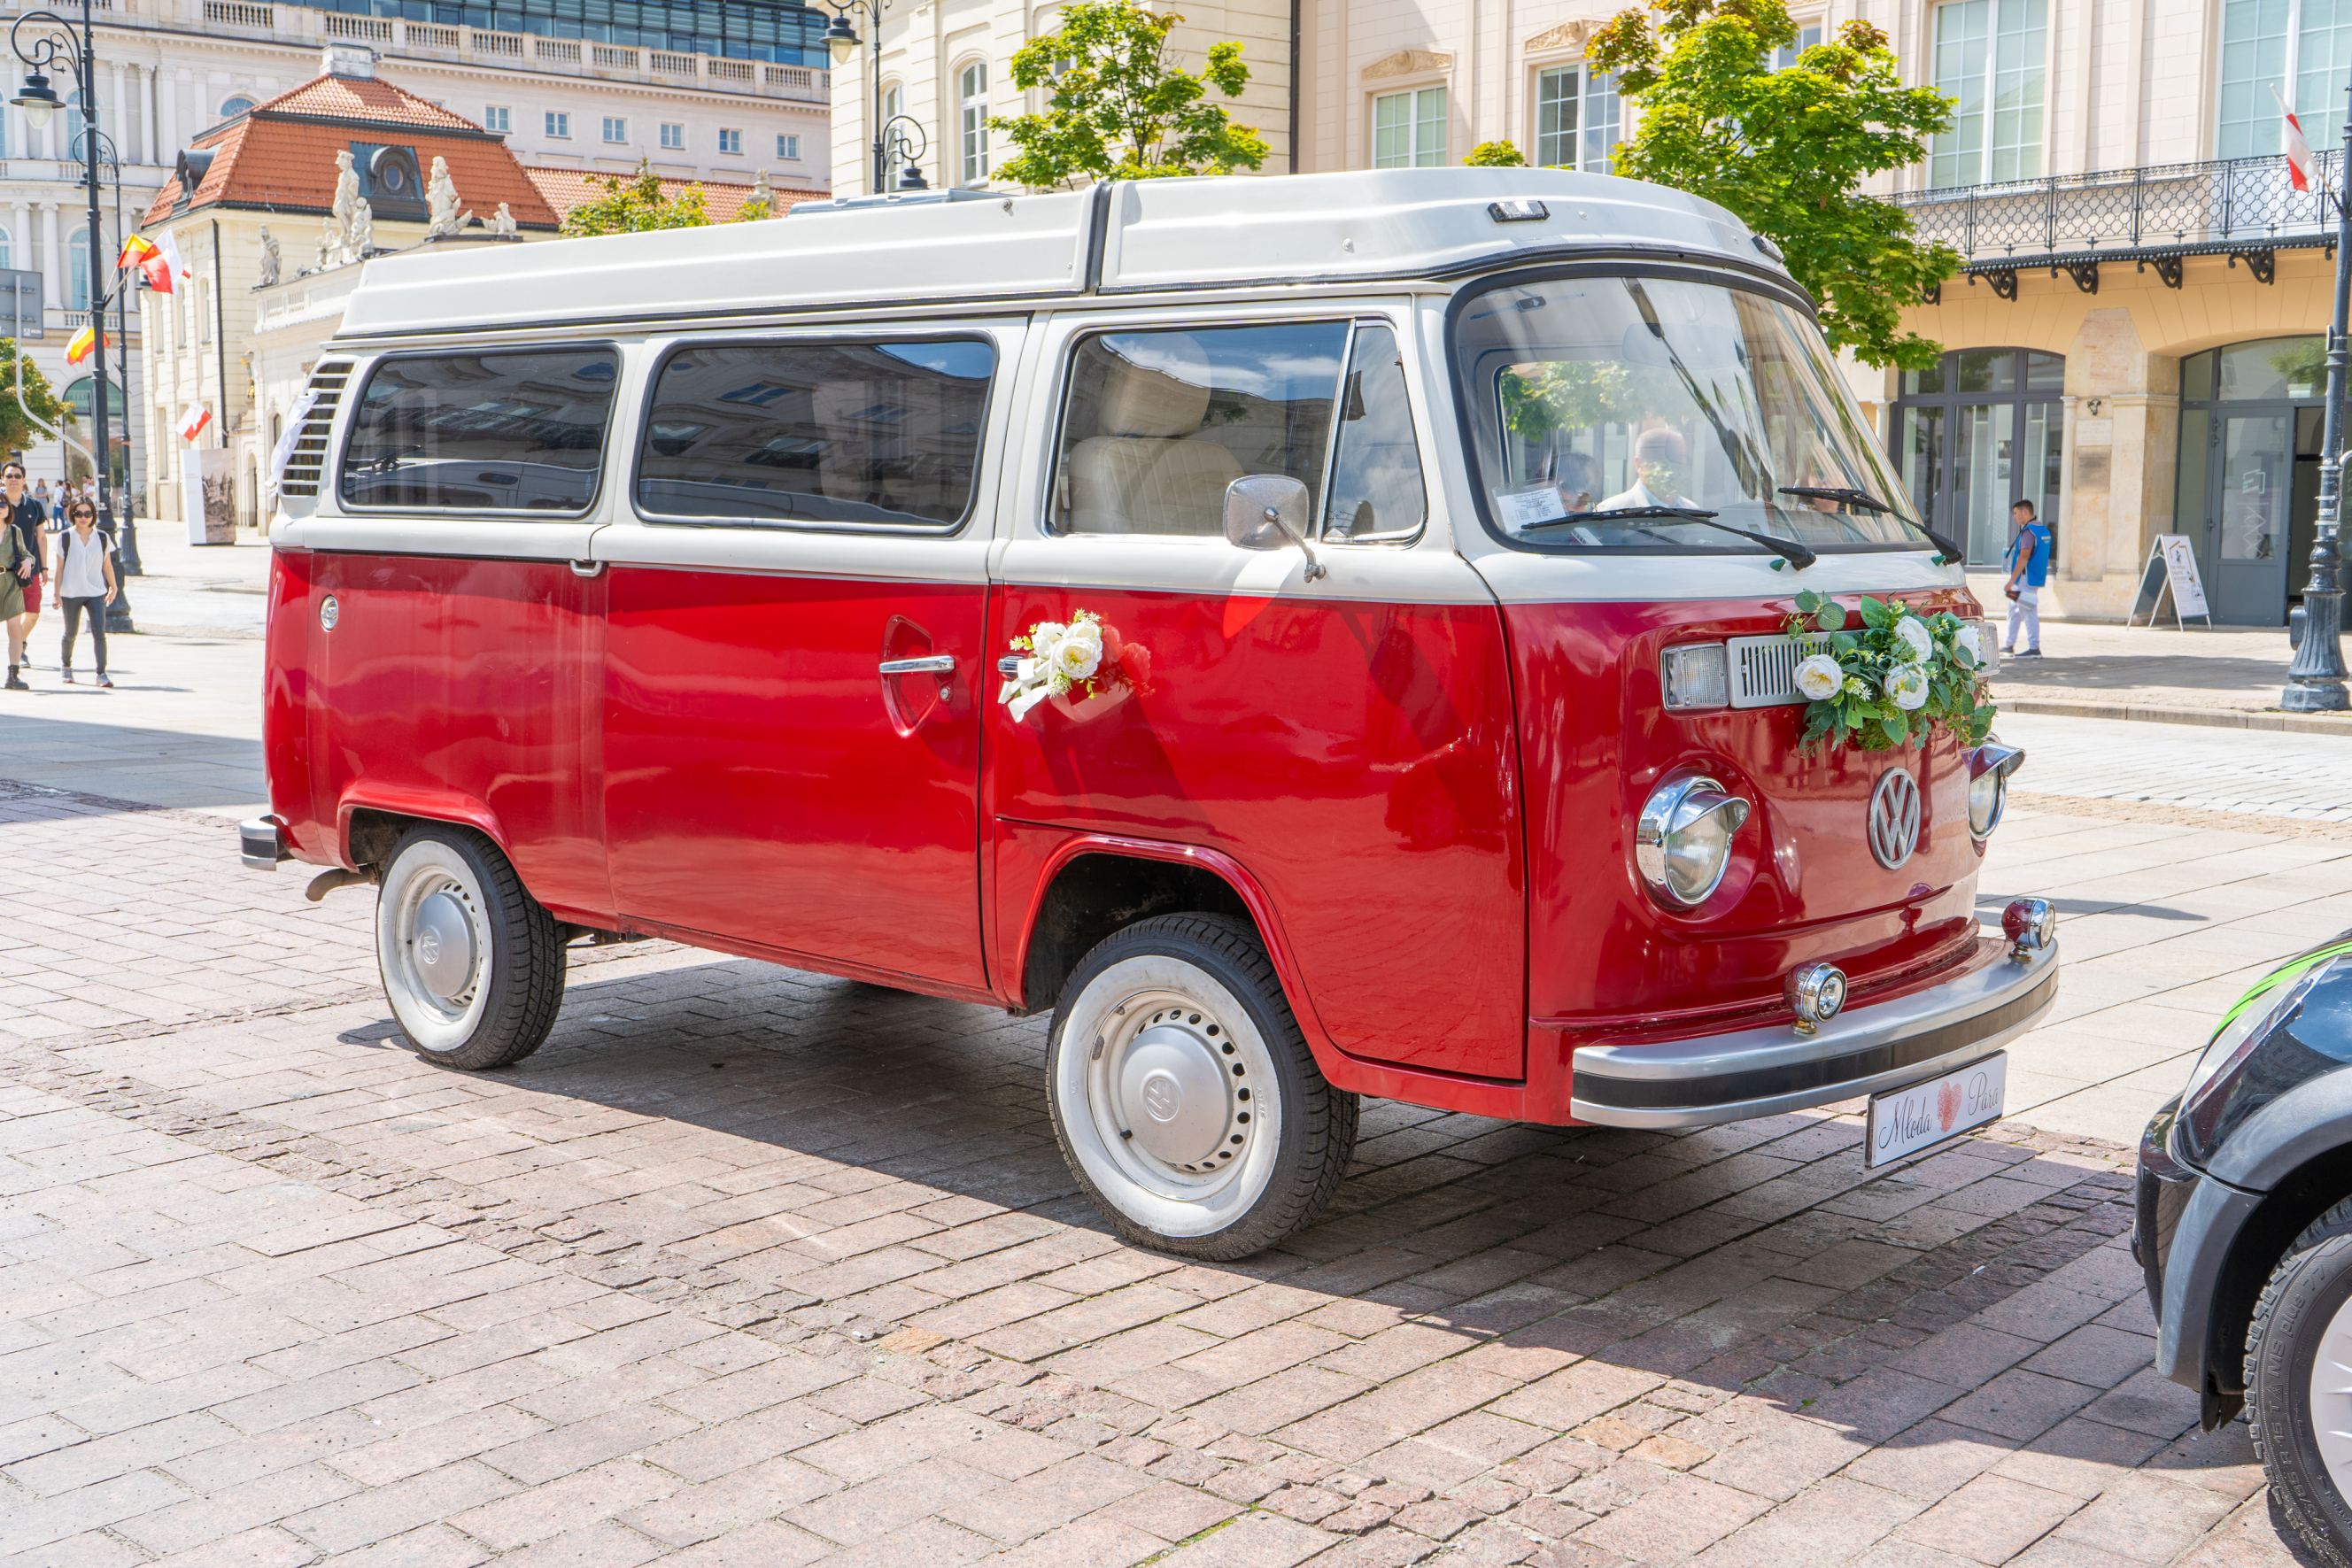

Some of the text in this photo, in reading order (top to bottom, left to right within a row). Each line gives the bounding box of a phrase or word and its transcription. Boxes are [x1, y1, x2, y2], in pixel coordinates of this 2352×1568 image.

[1874, 771, 1919, 866] VW
[1878, 1071, 1999, 1149] Młoda Para
[2280, 1293, 2306, 1339] plus
[2302, 1264, 2325, 1292] 77
